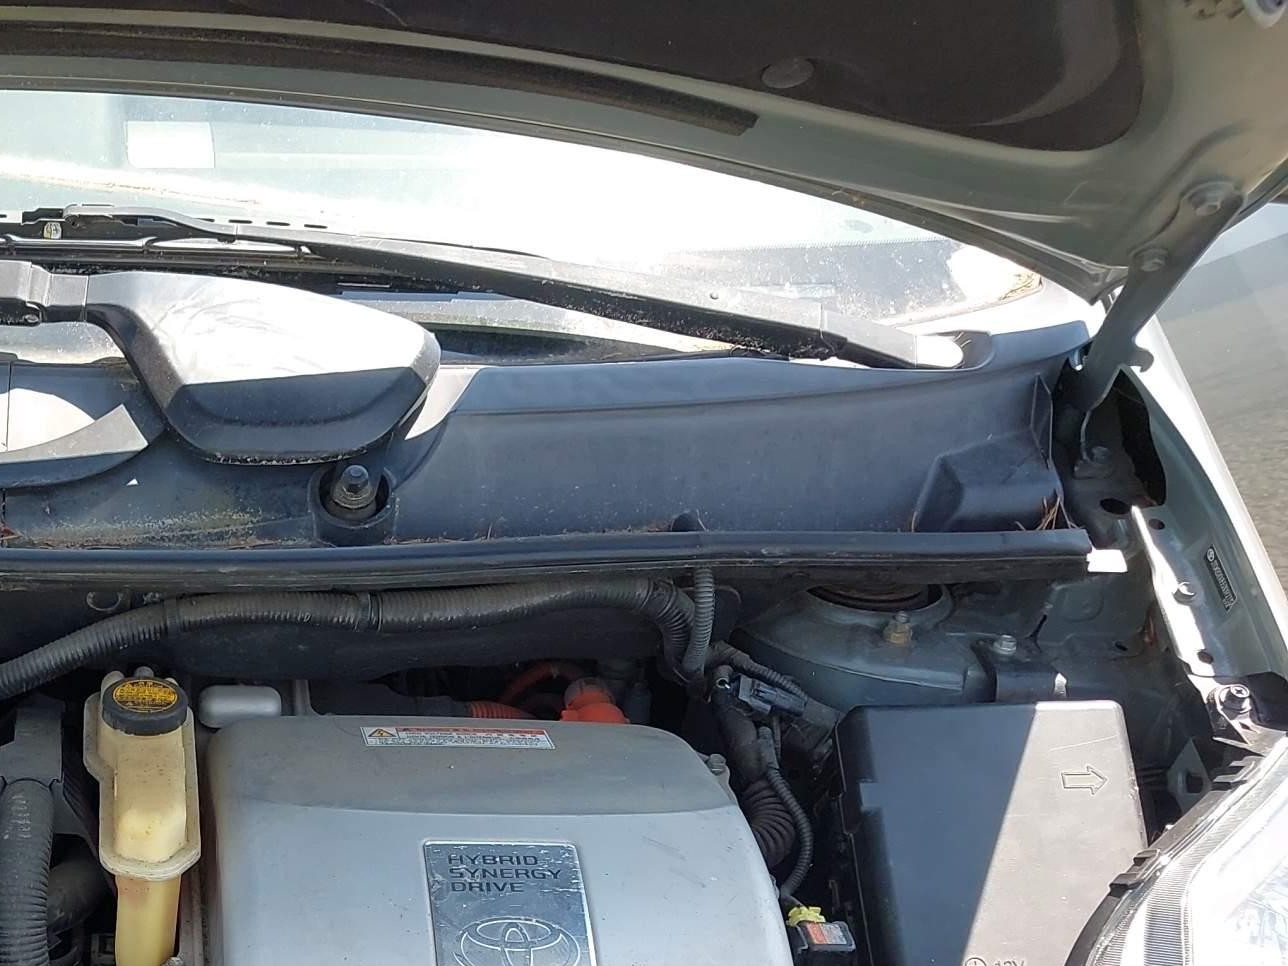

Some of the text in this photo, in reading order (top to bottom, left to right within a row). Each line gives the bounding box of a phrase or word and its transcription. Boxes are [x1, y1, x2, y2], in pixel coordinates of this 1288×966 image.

[448, 855, 538, 865] HYBRID
[449, 868, 561, 879] SYNERGY
[451, 881, 525, 892] DRIVE
